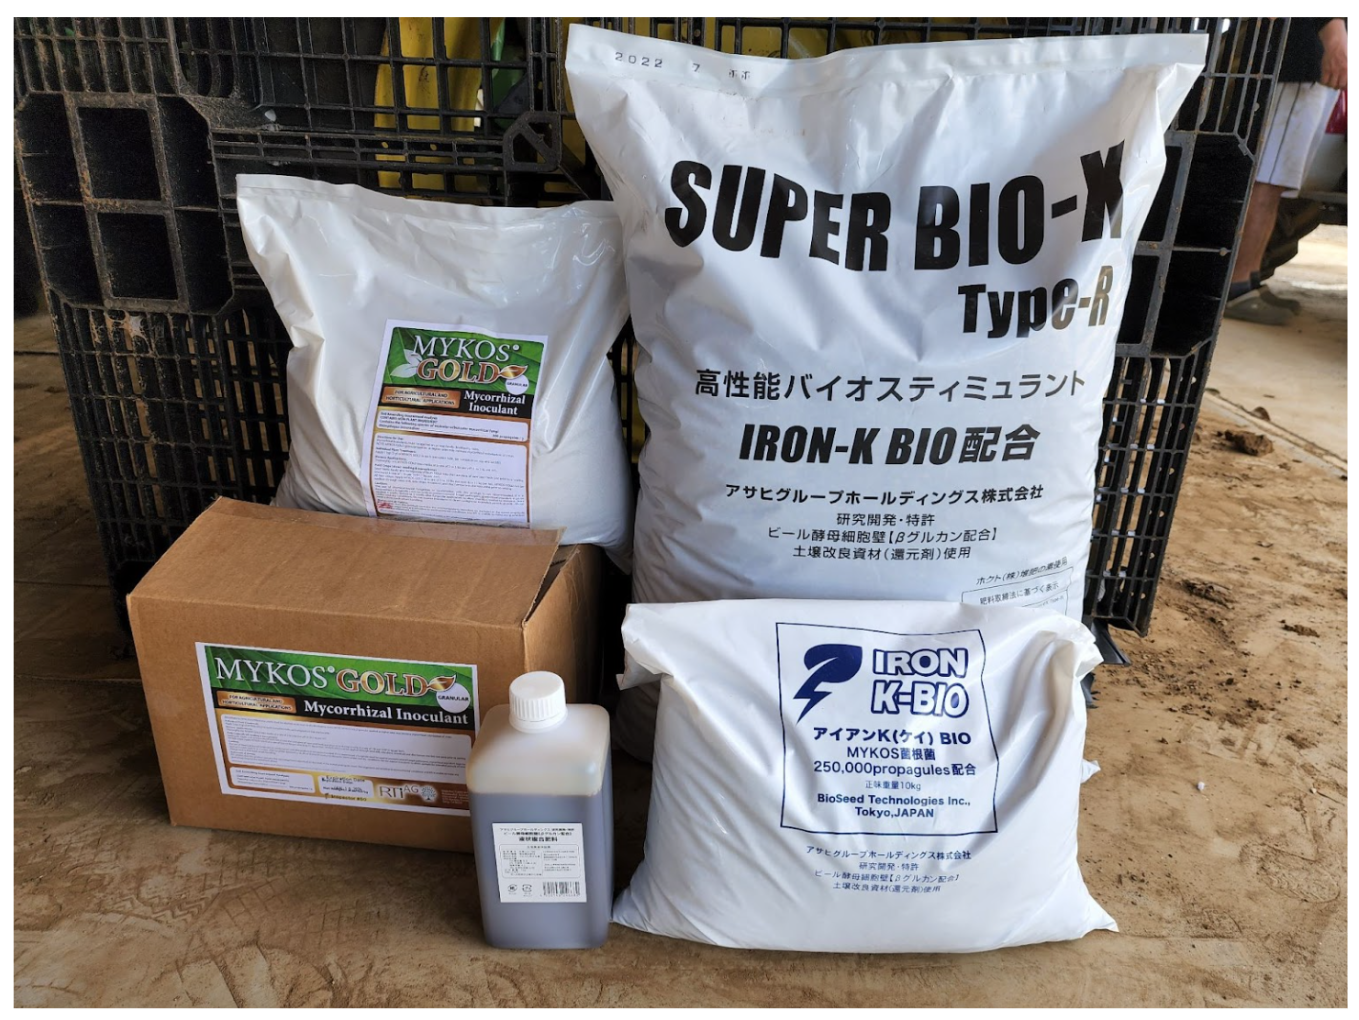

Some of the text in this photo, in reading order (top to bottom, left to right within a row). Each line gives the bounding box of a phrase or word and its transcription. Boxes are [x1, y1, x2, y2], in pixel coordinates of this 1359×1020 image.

[615, 51, 663, 68] 2022
[693, 63, 701, 73] 7
[664, 139, 1125, 271] SUPER BIO-X
[958, 265, 1114, 338] Type-R
[416, 357, 502, 384] GOLD
[695, 368, 1085, 402] 高性能バイオスティミュラント
[464, 390, 526, 405] Mycorrhizal
[469, 402, 518, 415] Inoculant
[739, 424, 881, 465] IRON-K
[726, 484, 1044, 506] アサヒグループホールディングス株式会社
[873, 648, 969, 678] IRON
[335, 669, 428, 697] GOLD
[871, 680, 970, 718] K-BIO
[304, 700, 469, 725] Mycorrhizal Inoculant
[940, 732, 972, 745] BIO
[847, 747, 936, 761] MYKOS菌根菌
[814, 761, 977, 777] 250,000propagules配合
[817, 793, 971, 807] BioSeed Technologies Inc.,
[855, 807, 934, 819] Tokyo,JAPAN
[806, 845, 972, 860] アサヒグループホールディングス株式会社
